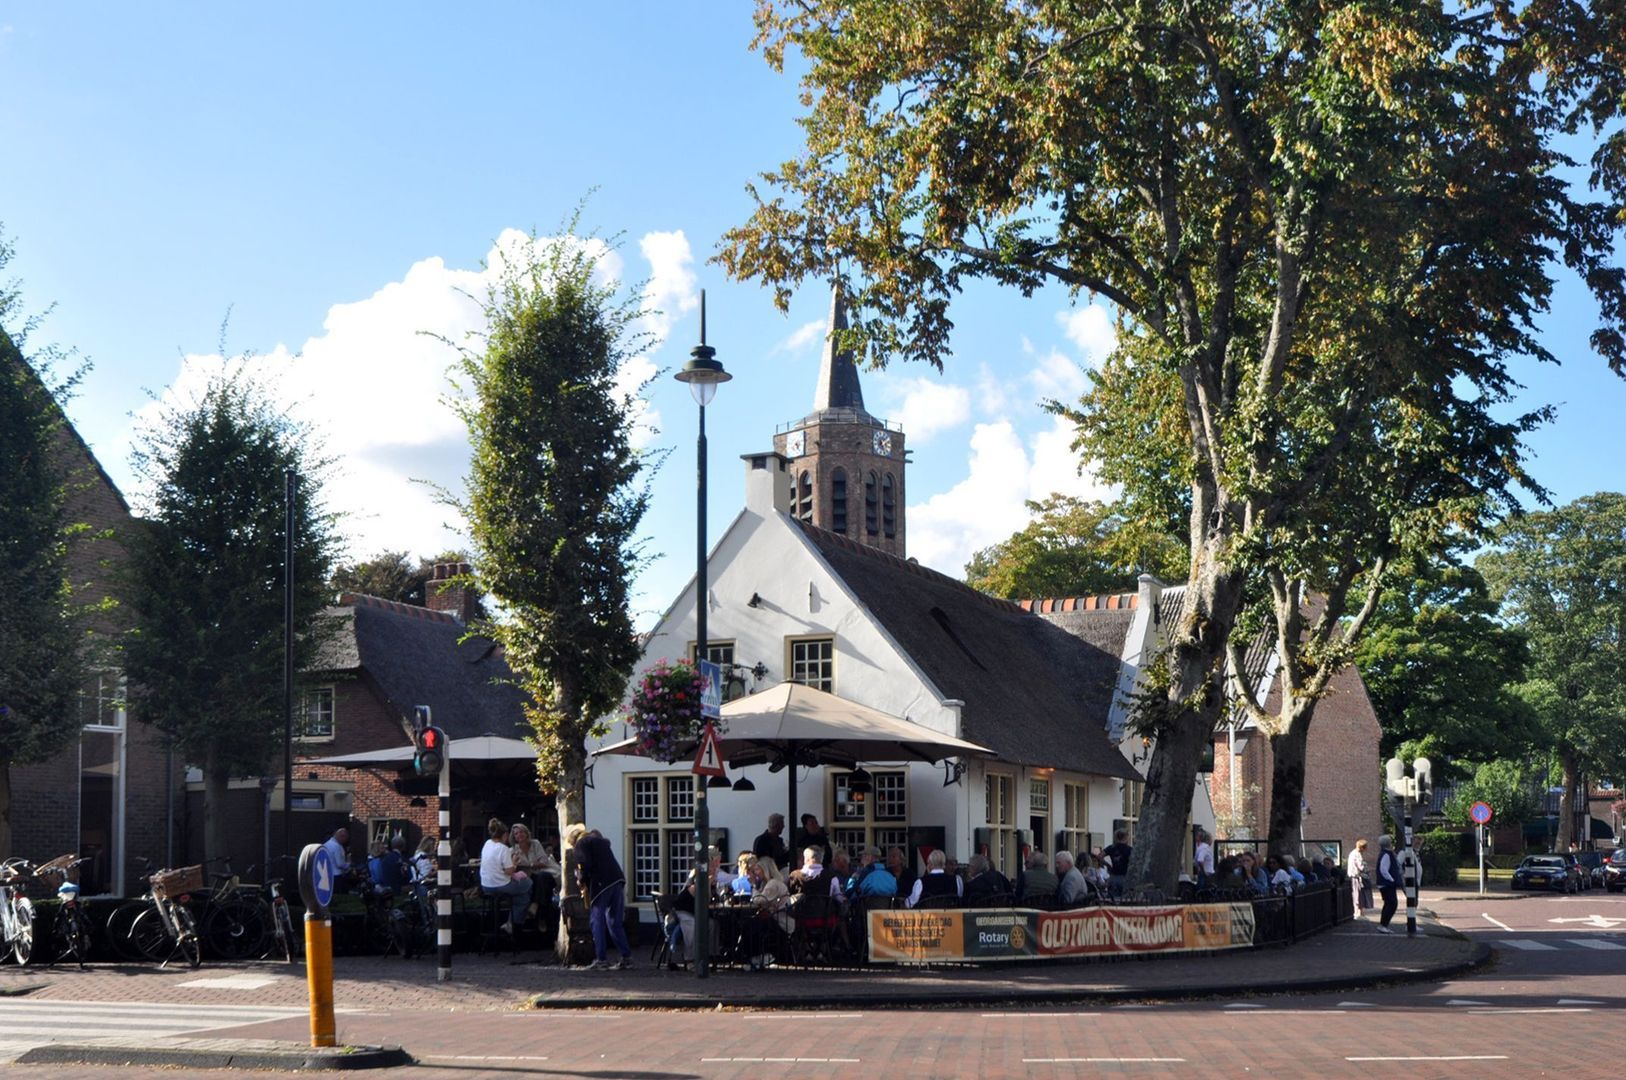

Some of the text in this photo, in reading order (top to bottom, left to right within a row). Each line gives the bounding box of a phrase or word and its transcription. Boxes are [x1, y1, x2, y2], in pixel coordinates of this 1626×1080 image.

[978, 931, 1010, 944] Rotary
[1041, 914, 1183, 949] OLDTIMER MEERIJDAG
